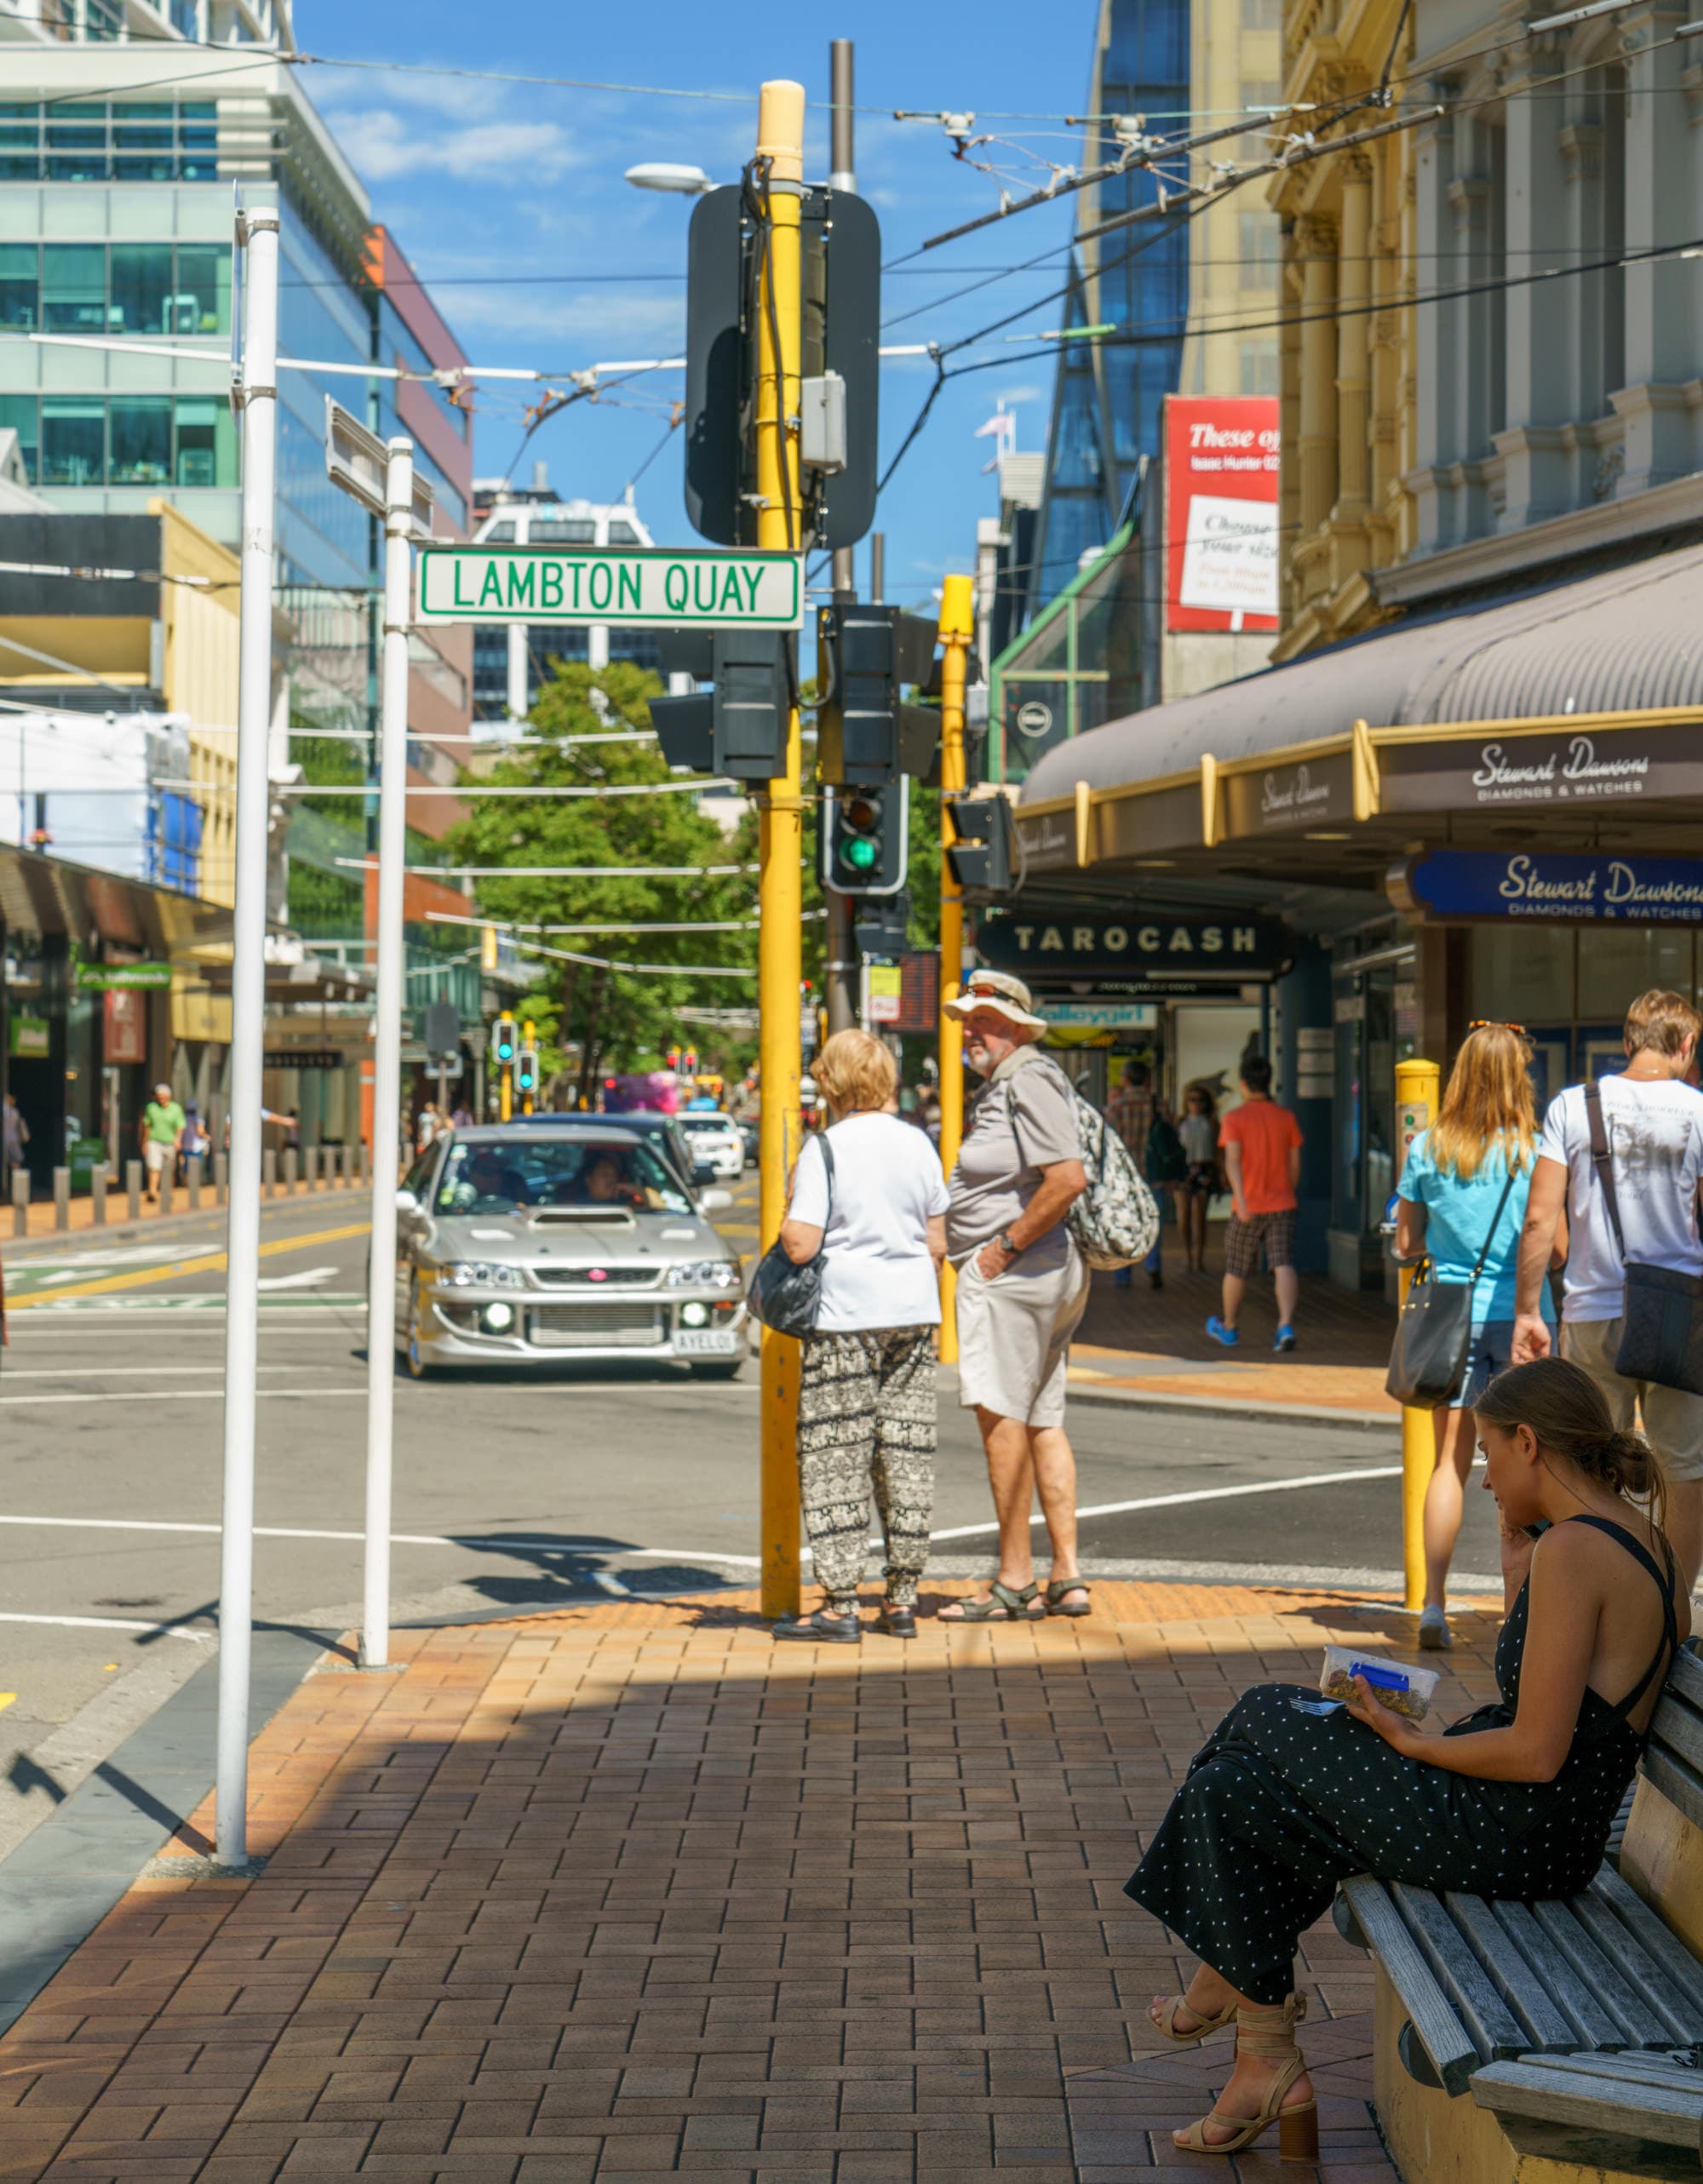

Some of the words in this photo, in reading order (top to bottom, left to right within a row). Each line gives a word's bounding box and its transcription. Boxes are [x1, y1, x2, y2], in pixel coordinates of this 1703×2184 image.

[1190, 423, 1255, 448] These
[453, 559, 642, 610] LAMBTON
[664, 563, 766, 614] QUAY
[1472, 743, 1557, 787] Stewart
[1562, 736, 1649, 779] Dawsons
[1477, 786, 1553, 801] DIAMONDS
[1557, 785, 1569, 797] &
[1574, 780, 1643, 796] WATCHES
[1499, 855, 1597, 900] Stewart
[1508, 903, 1596, 918] DIAMONDS
[1604, 906, 1615, 918] &
[1626, 906, 1702, 920] WATCHES
[1014, 926, 1257, 952] TAROCASH
